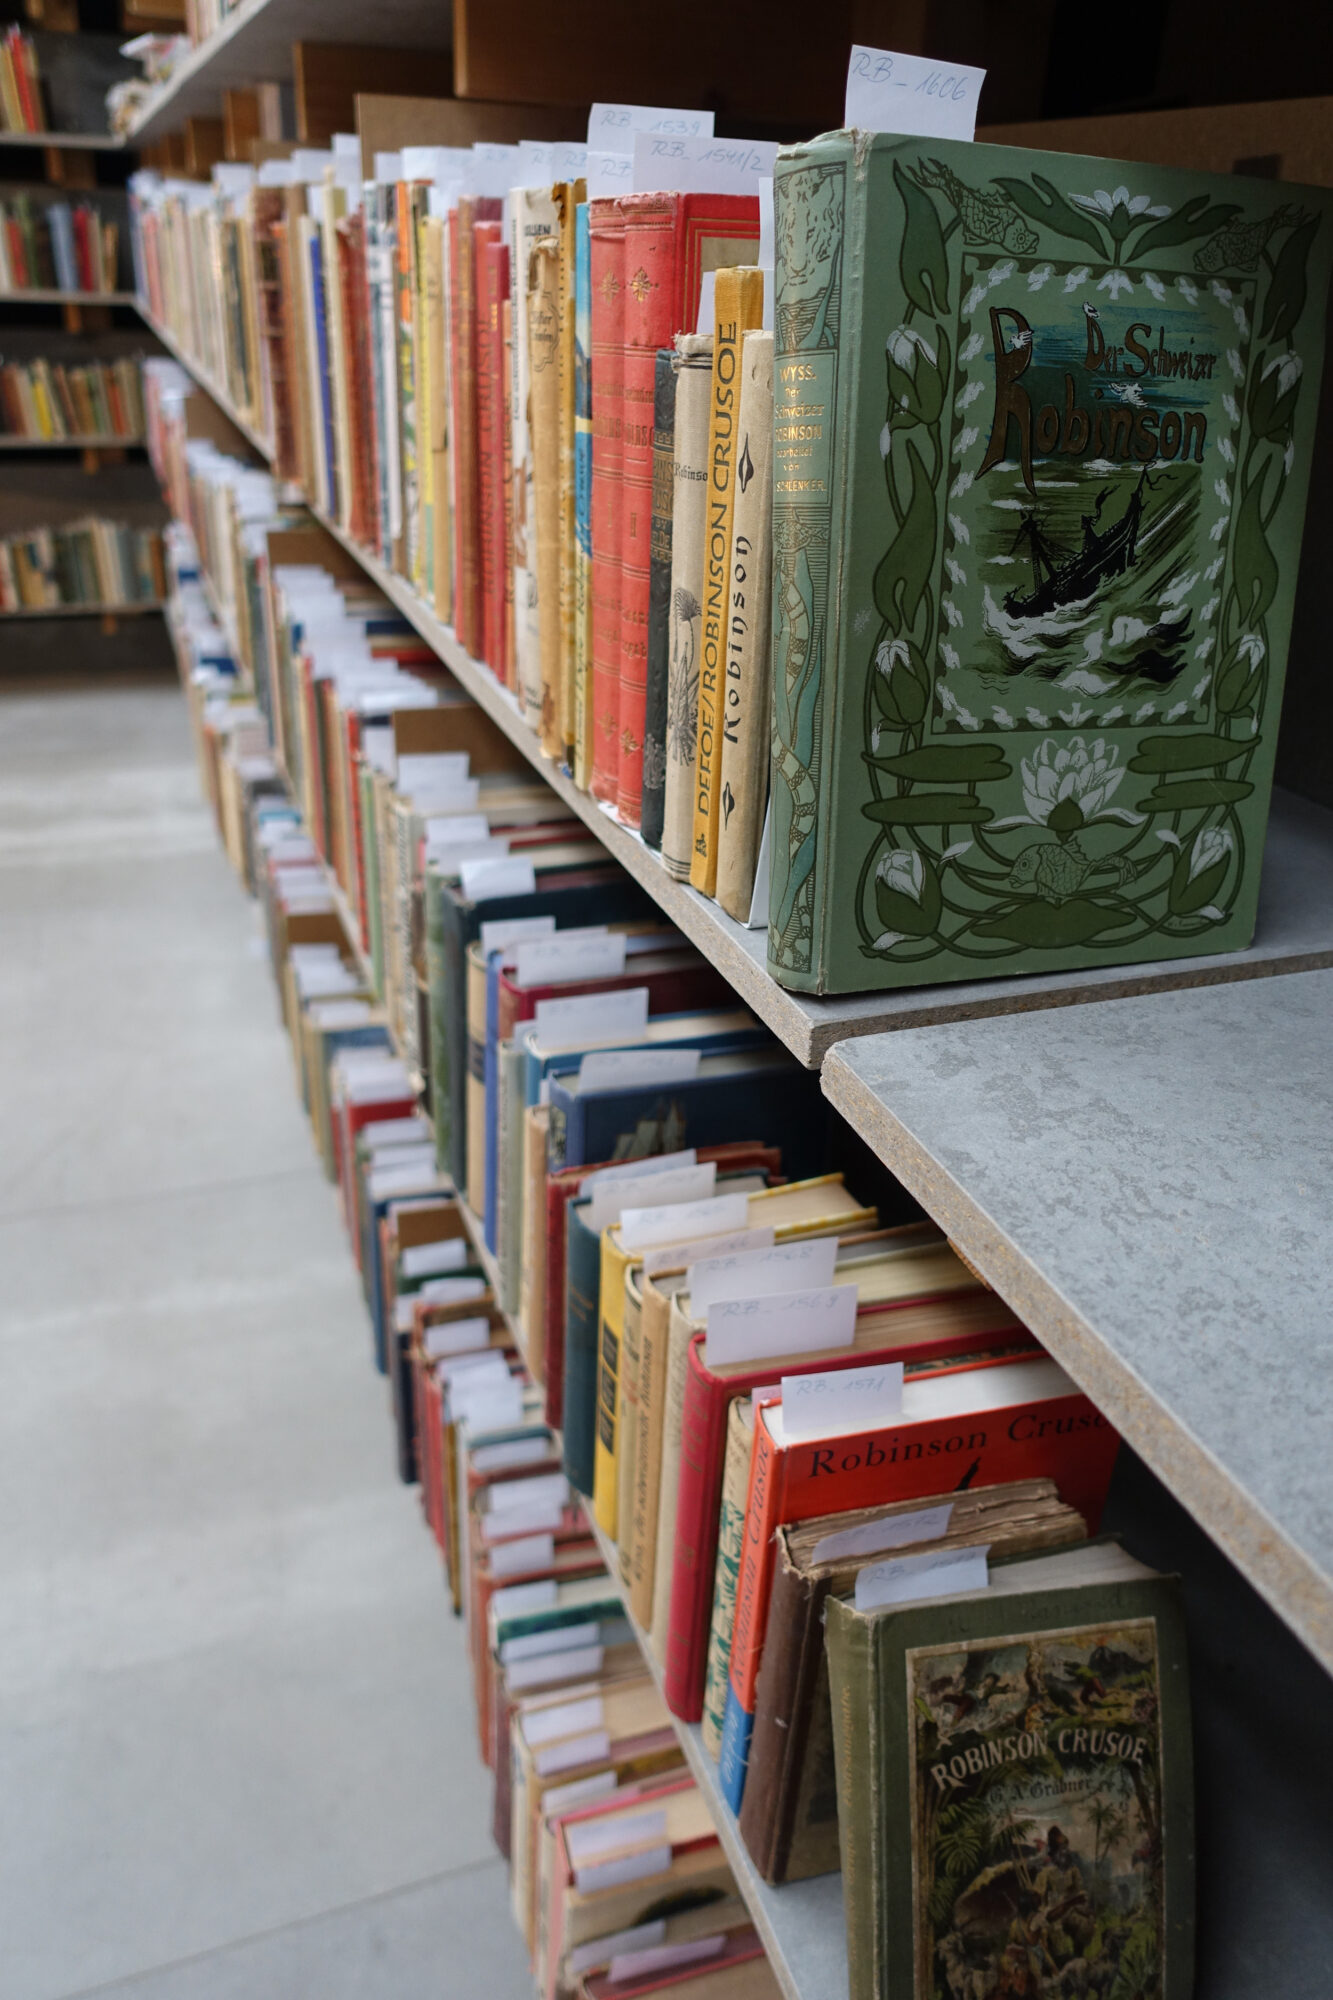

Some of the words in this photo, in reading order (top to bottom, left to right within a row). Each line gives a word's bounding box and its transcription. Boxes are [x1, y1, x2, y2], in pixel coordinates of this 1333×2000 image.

[915, 71, 968, 101] 1606
[712, 321, 738, 493] CRUSOE
[974, 306, 1207, 497] Robinson
[723, 535, 753, 744] Robinson
[747, 1434, 771, 1545] Crusoe
[808, 1426, 988, 1479] Robinson
[1008, 1412, 1108, 1443] Cruso
[930, 1728, 1048, 1791] ROBINSON
[1058, 1728, 1149, 1766] CRUSOE
